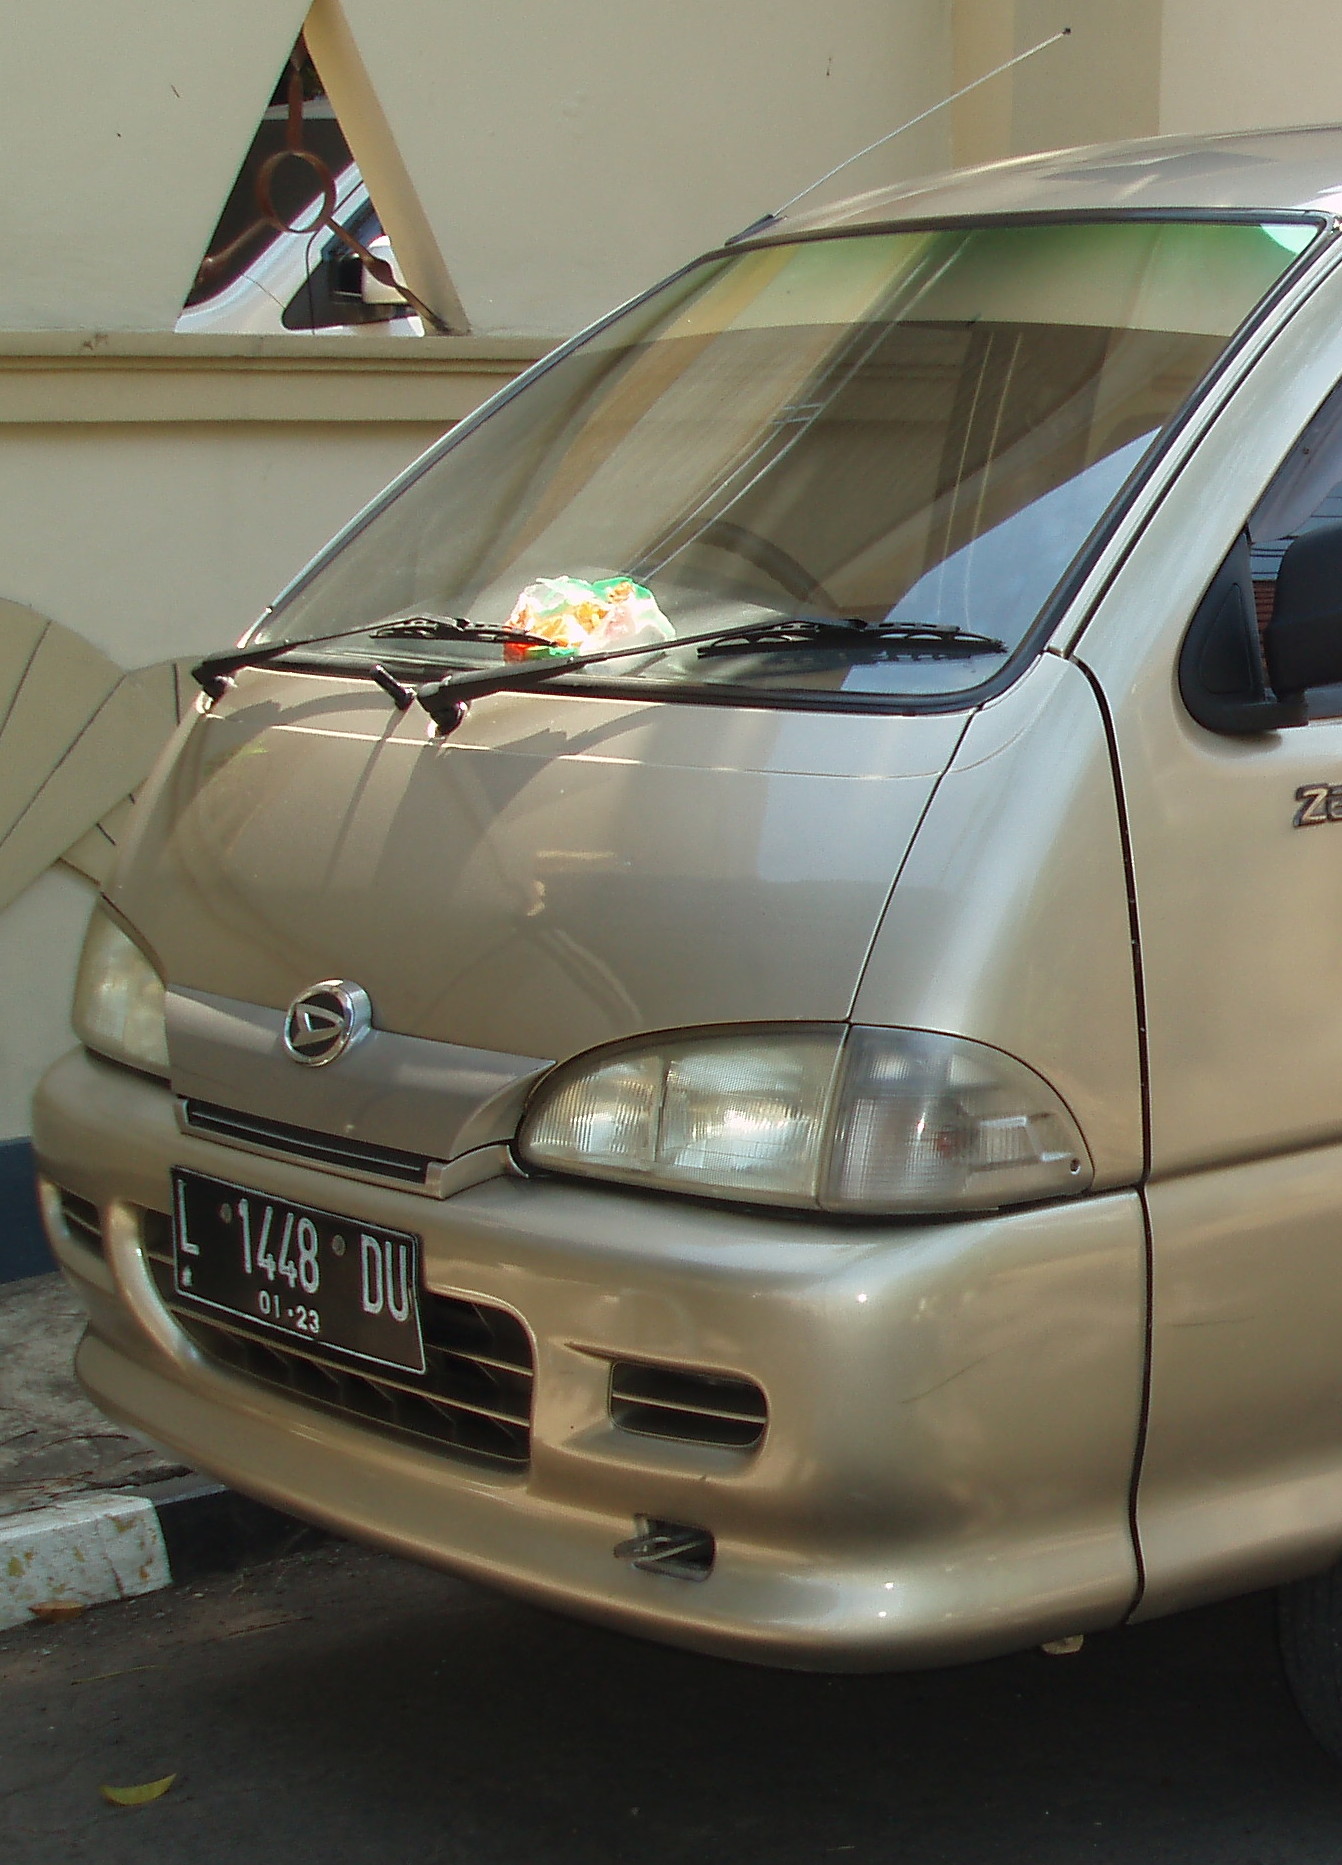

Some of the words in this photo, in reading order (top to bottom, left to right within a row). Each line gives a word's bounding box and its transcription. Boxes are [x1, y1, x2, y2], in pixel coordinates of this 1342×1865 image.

[177, 1179, 200, 1256] L
[238, 1198, 320, 1294] 1448
[360, 1233, 410, 1322] DU
